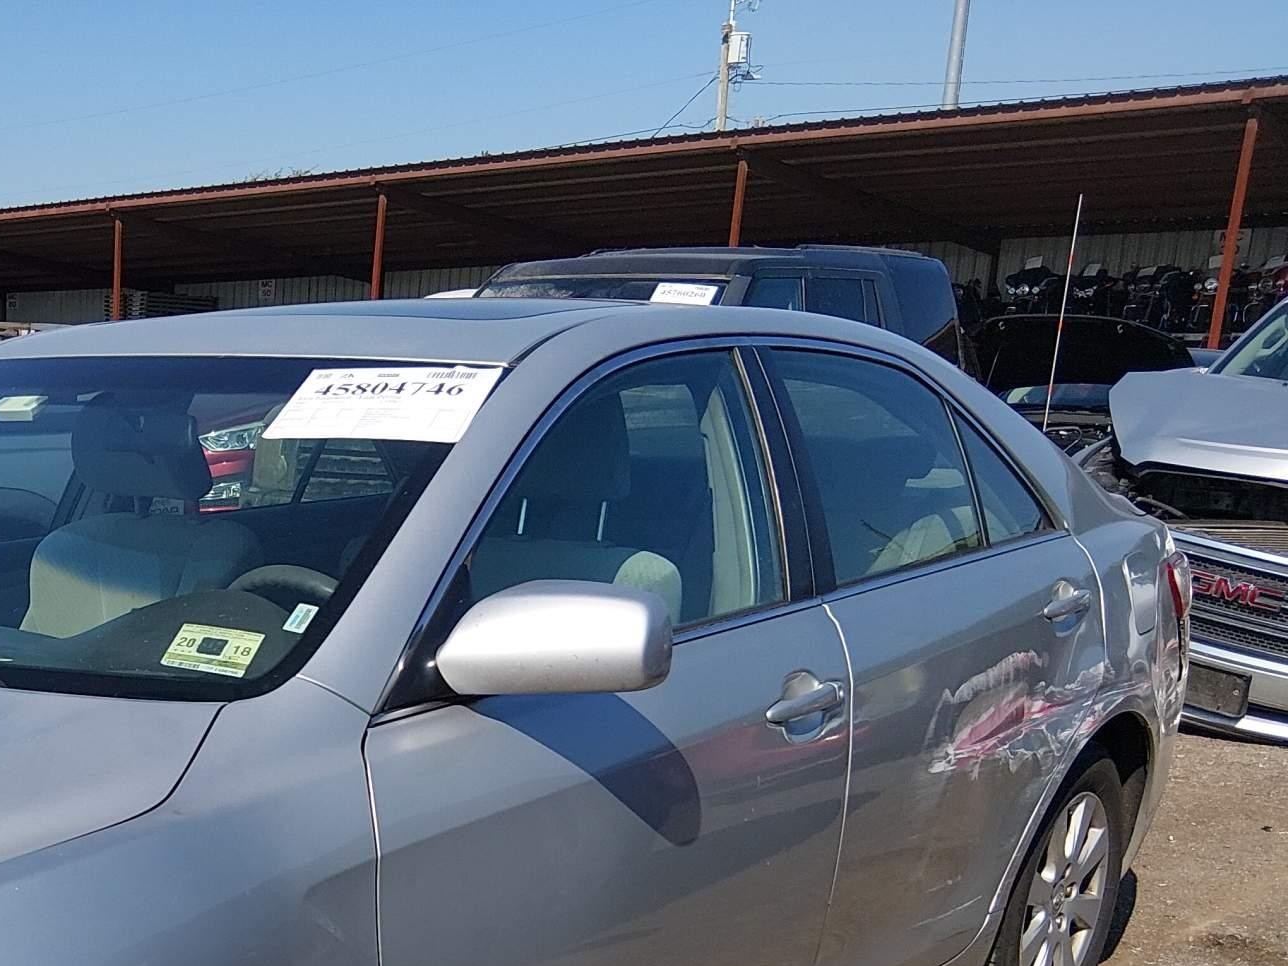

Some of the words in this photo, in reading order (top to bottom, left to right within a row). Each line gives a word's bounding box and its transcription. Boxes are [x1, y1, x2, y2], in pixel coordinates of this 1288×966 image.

[314, 381, 465, 396] 45804746
[1190, 568, 1285, 612] GMC
[176, 636, 197, 648] 20
[233, 644, 252, 657] 18
